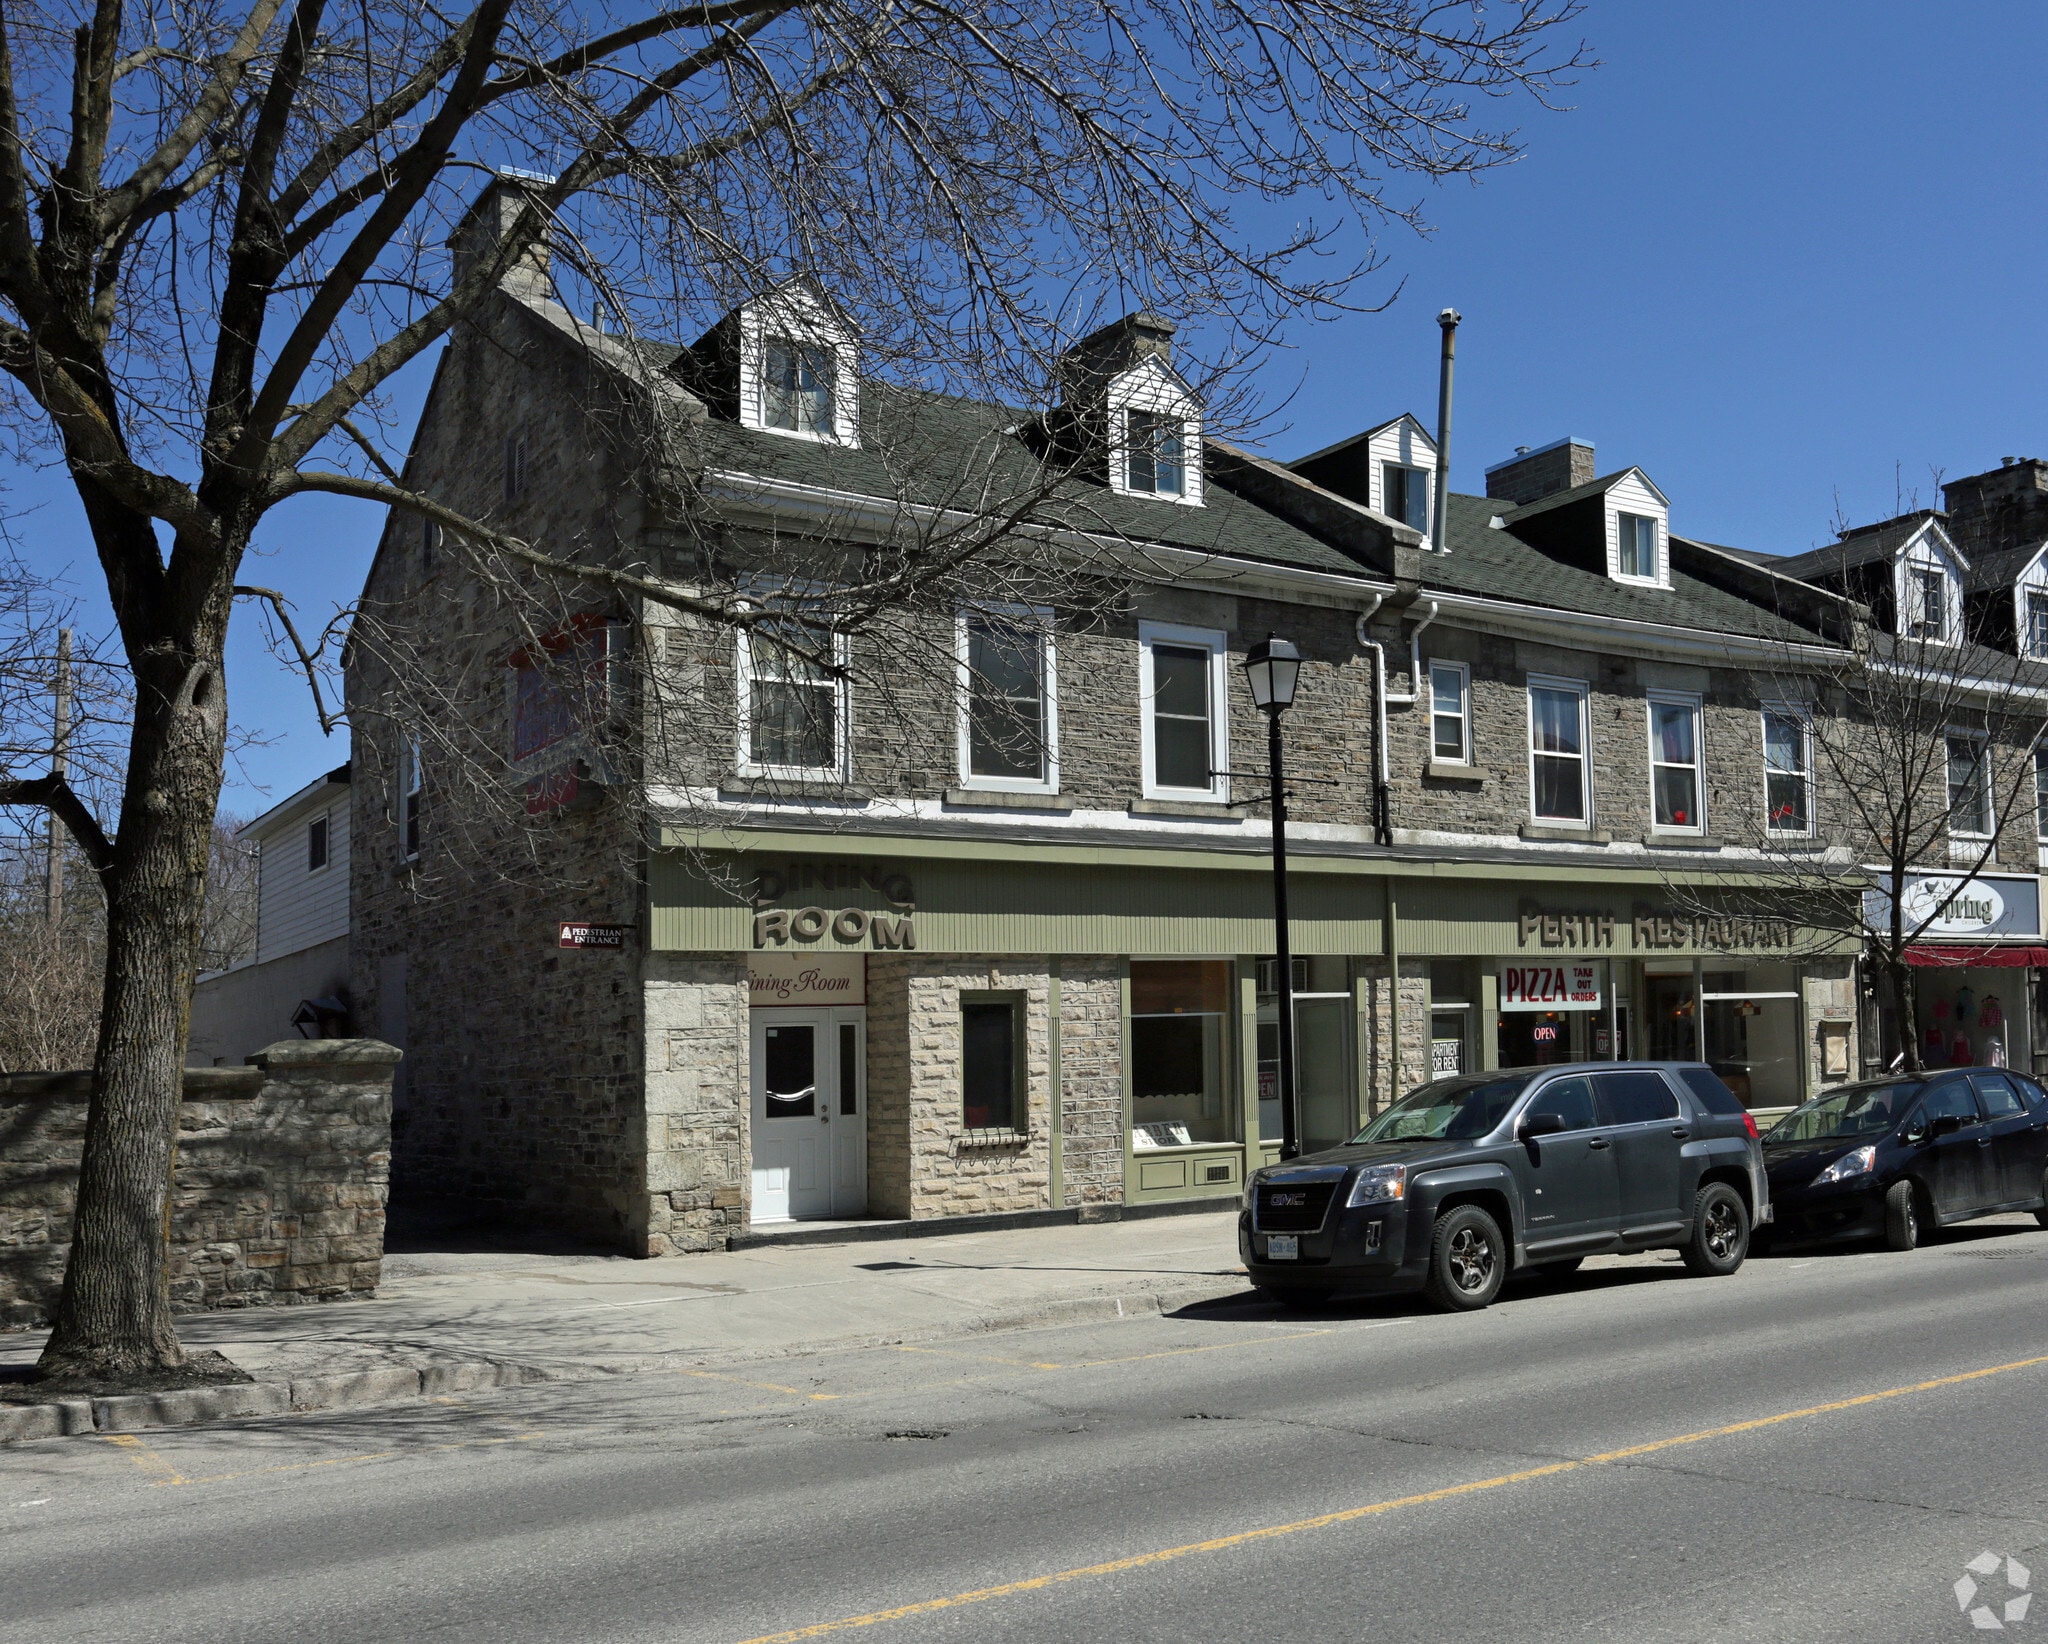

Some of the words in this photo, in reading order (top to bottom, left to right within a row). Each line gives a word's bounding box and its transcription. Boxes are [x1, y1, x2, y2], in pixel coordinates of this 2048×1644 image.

[754, 863, 915, 912] DINING
[754, 906, 916, 949] ROOM
[1519, 899, 1615, 944] PERTH
[572, 928, 621, 937] PEDESTRIAN
[574, 935, 620, 945] ENTRANCE
[1573, 968, 1594, 978] TAKE
[747, 970, 792, 999] ining
[793, 968, 849, 991] Room
[1506, 967, 1568, 1003] PIZZA
[1577, 980, 1592, 990] OUT
[1571, 992, 1597, 1002] ORDERS
[1534, 1027, 1556, 1041] OPEN
[1443, 1056, 1460, 1070] RENT
[1133, 1122, 1184, 1138] ARBER
[1270, 1193, 1306, 1206] GMC
